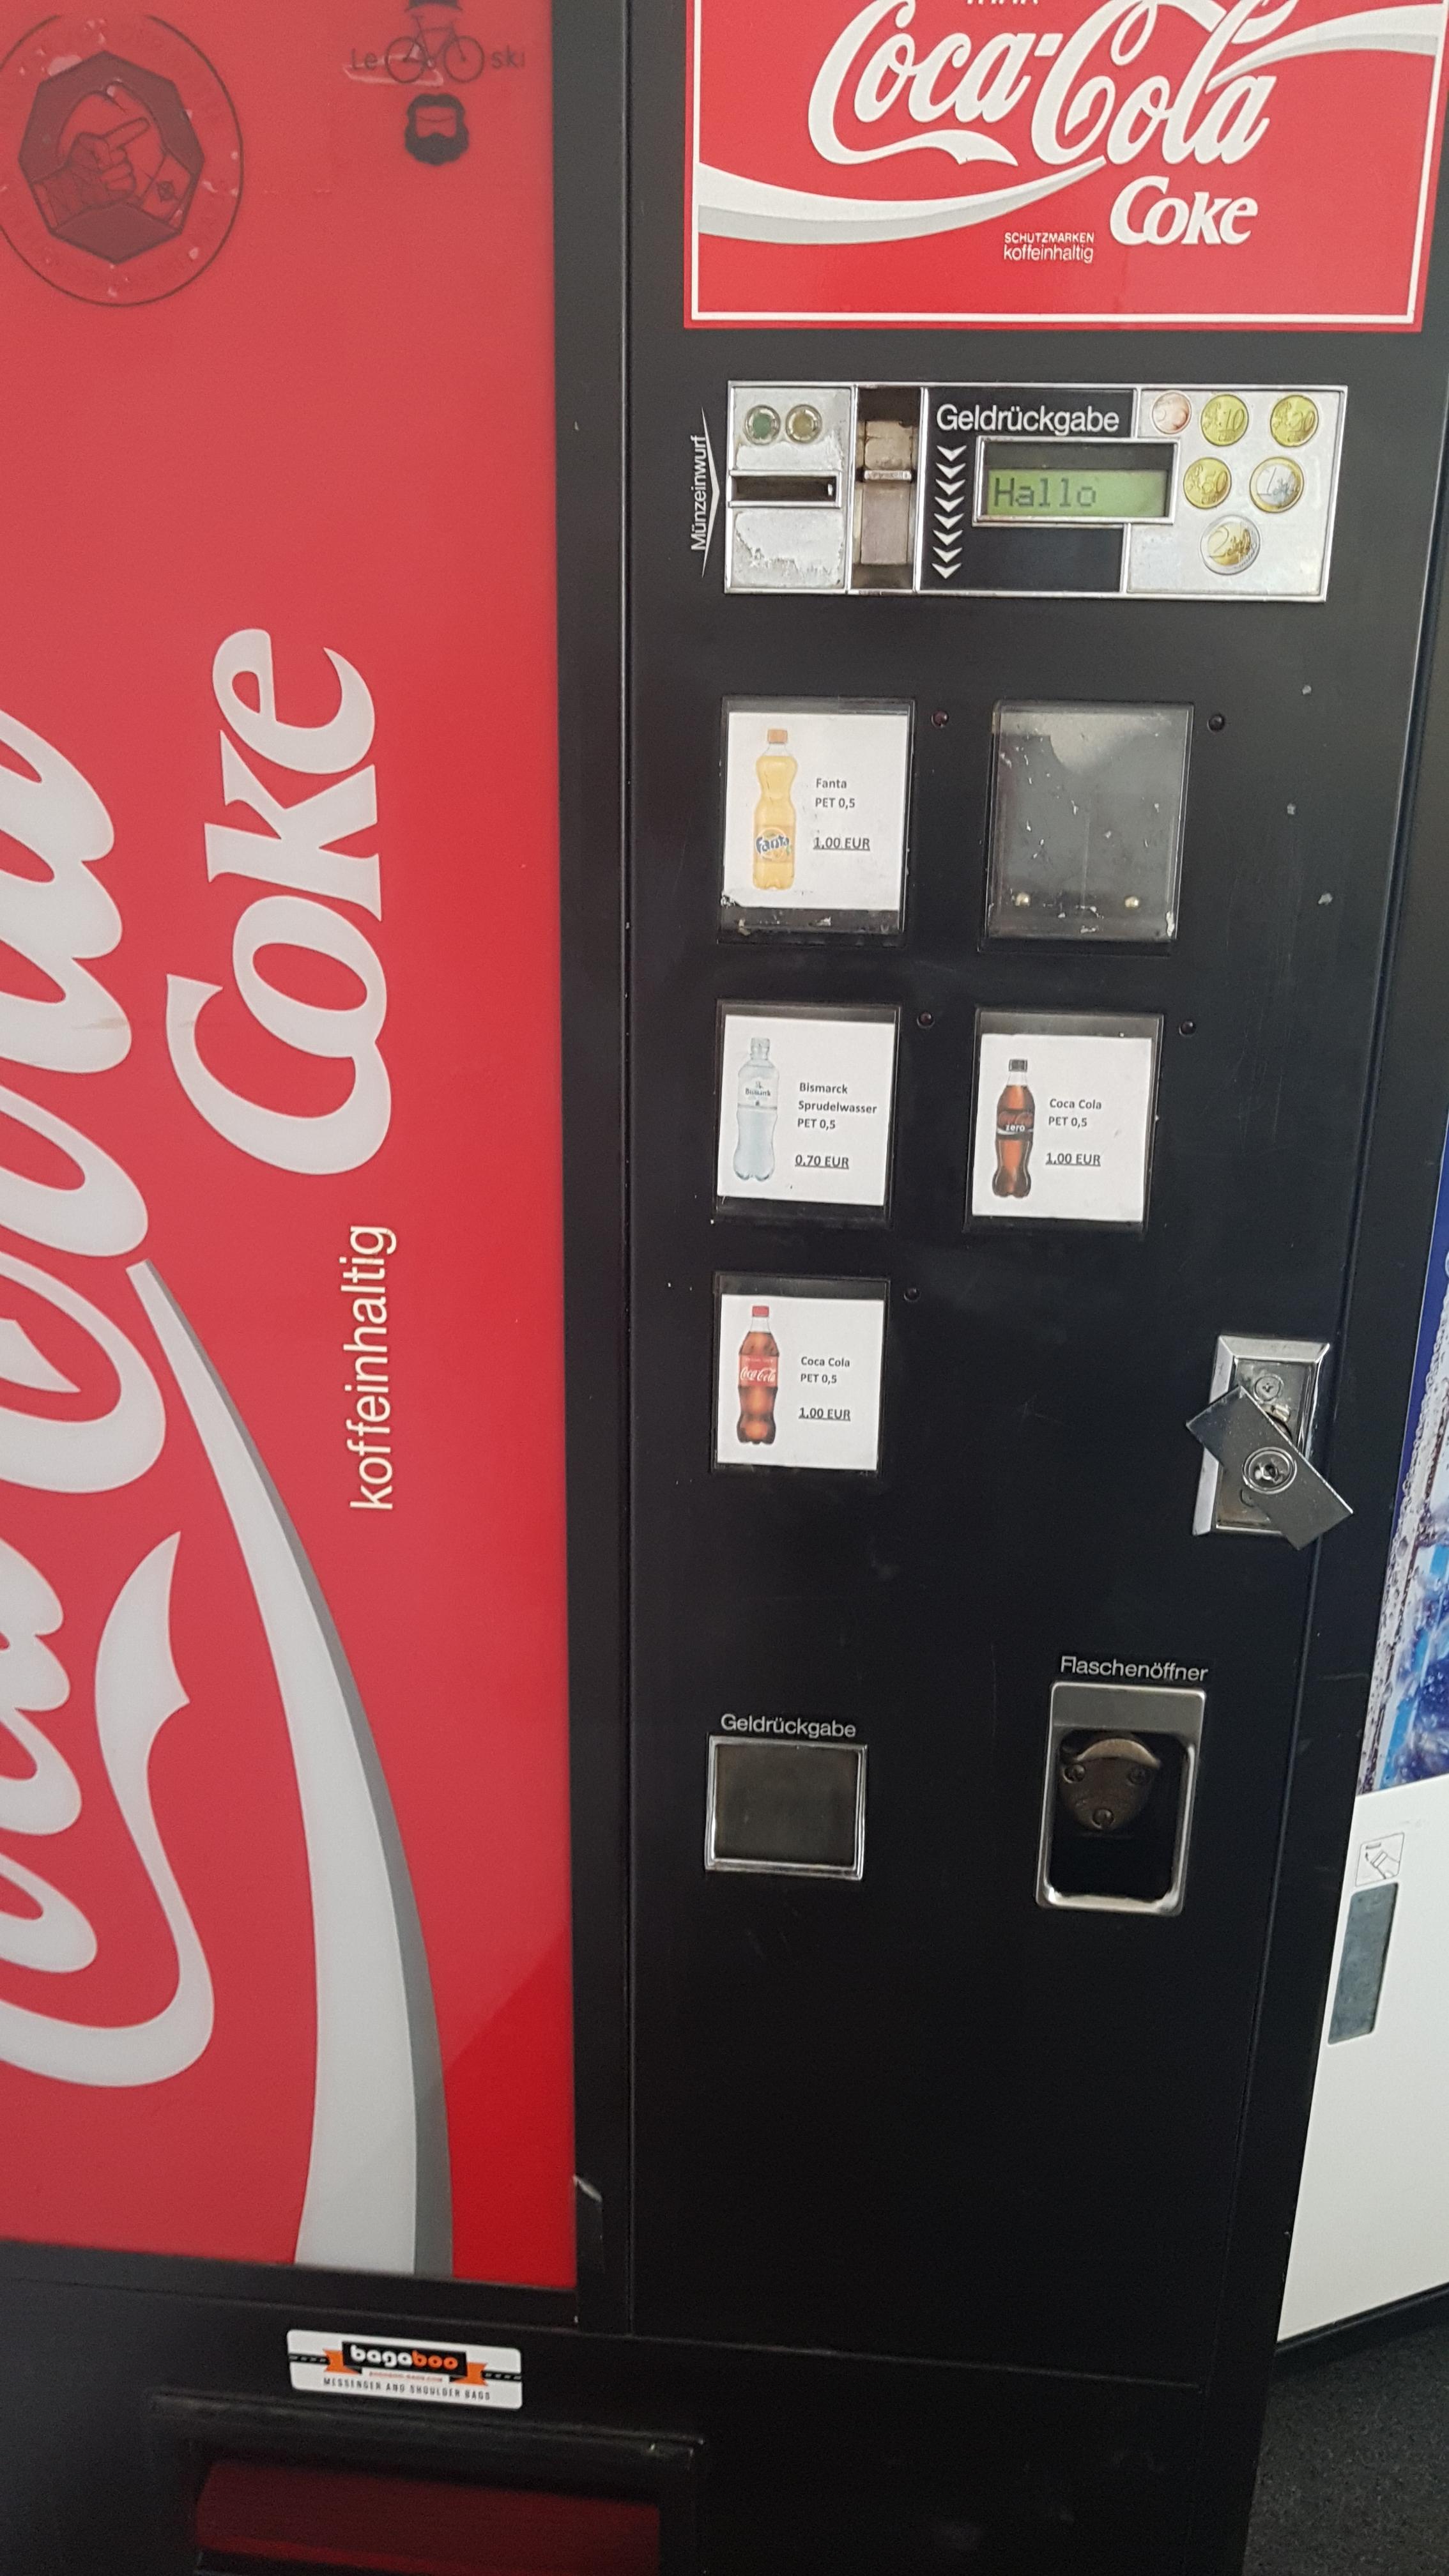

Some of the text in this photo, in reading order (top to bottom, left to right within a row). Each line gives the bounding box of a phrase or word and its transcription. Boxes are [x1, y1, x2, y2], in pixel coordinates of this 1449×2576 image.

[808, 0, 1278, 166] Coca-Cola
[1110, 176, 1259, 246] Coke
[1004, 232, 1094, 243] SCHUTZMARKEN
[1004, 244, 1094, 264] koffeinhaltig
[937, 404, 1119, 436] Geldrückgabe
[691, 435, 707, 550] Münzeinwurf
[993, 477, 1097, 507] Hallo
[816, 778, 847, 789] Fanta
[815, 798, 855, 809] PET 0,5
[845, 837, 870, 850] EUR
[166, 628, 392, 1175] Coke
[799, 1082, 848, 1094] Bismarck
[798, 1101, 877, 1114] Sprudelwasser
[1049, 1098, 1102, 1110] Coca Cola
[797, 1118, 836, 1131] PET 0,5
[1048, 1116, 1087, 1129] PET 0,5
[824, 1156, 849, 1169] EUR
[1076, 1153, 1101, 1167] EUR
[339, 1225, 397, 1510] koffeinhaltig
[801, 1356, 850, 1367] Coca Cola
[800, 1374, 837, 1384] PET 0,5
[827, 1409, 851, 1422] EUR
[1061, 1655, 1208, 1682] Flaschenöffner
[721, 1713, 856, 1738] Geldrückgabe
[349, 2344, 459, 2371] bagaboo
[323, 2377, 382, 2392] MESSENGER
[386, 2382, 405, 2393] AND
[410, 2385, 461, 2398] SHOULDER
